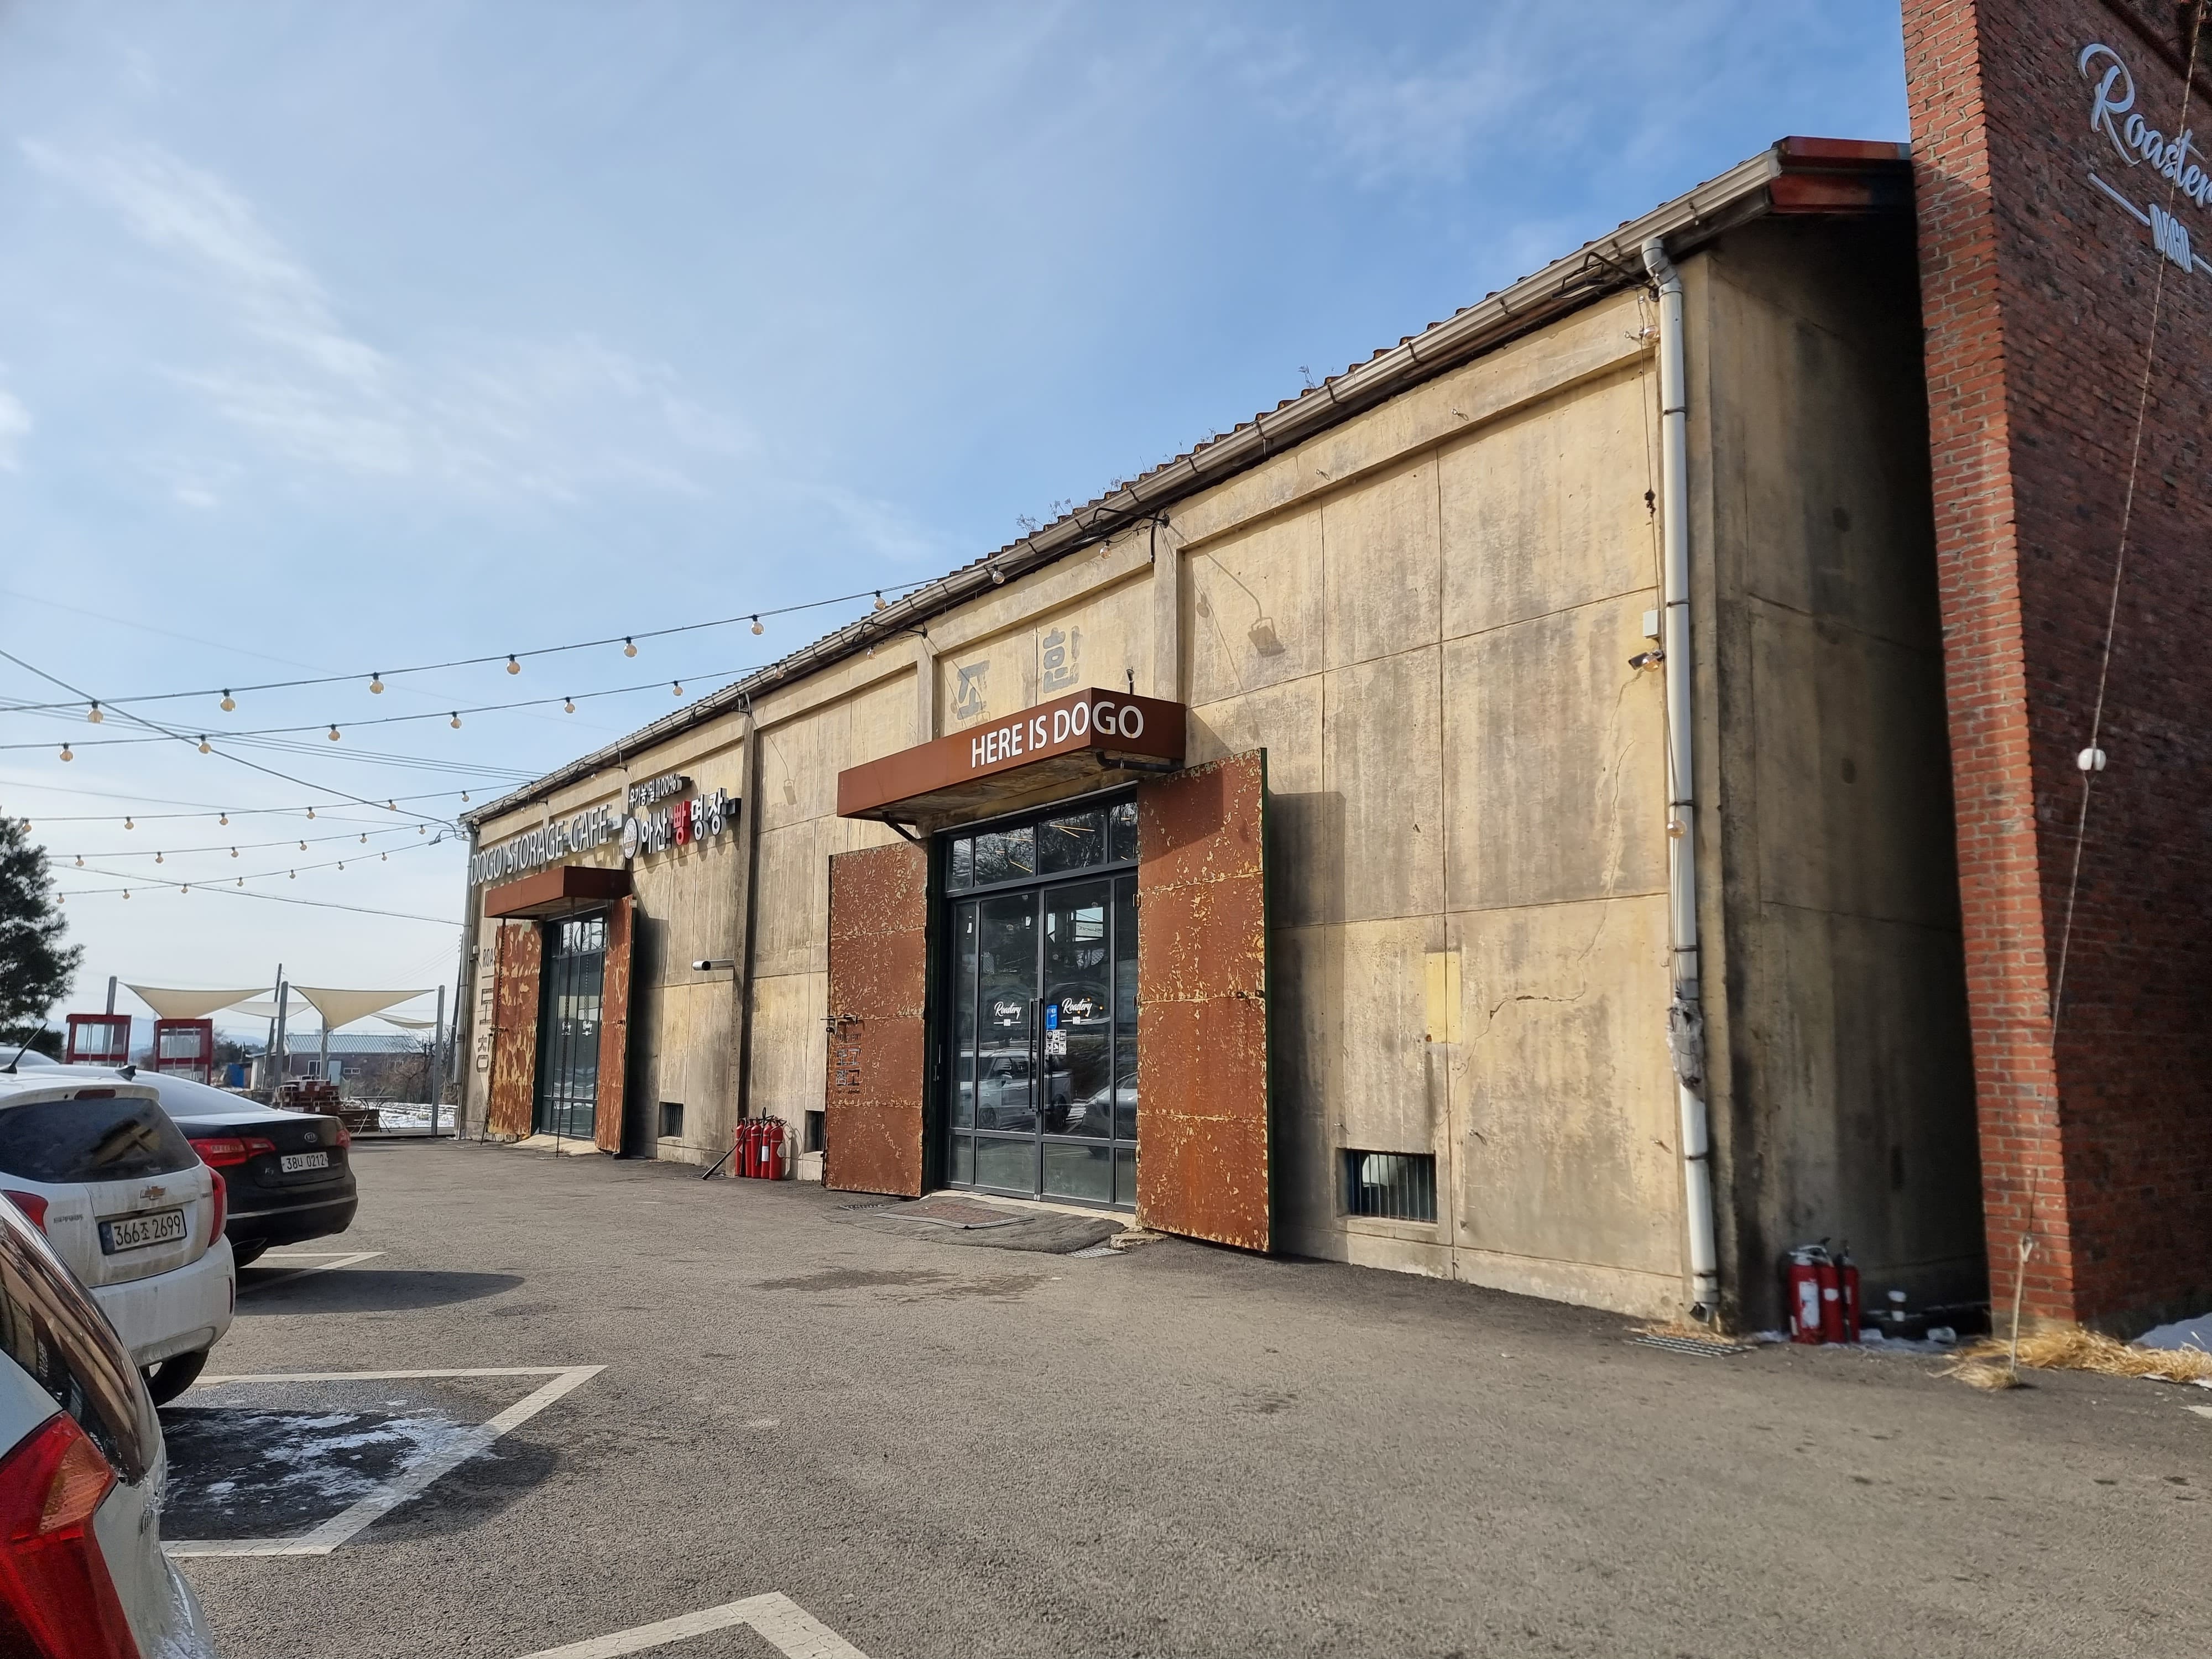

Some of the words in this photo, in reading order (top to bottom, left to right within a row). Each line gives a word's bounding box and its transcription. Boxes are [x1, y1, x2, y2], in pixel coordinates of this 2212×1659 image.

[972, 723, 1022, 768] HERE
[1029, 715, 1047, 752] IS
[1053, 701, 1144, 744] DOGO
[629, 784, 647, 809] 유기농
[649, 779, 655, 802] 밀
[658, 774, 677, 797] 100%
[471, 844, 503, 886] DOGO
[507, 820, 565, 874] STORAGE
[570, 804, 609, 853] CAFE
[482, 948, 494, 968] ROA
[994, 1001, 1022, 1020] Roastery
[1062, 998, 1092, 1018] Roastery
[306, 1154, 325, 1167] 0212
[113, 1222, 149, 1246] 366조
[154, 1214, 181, 1239] 2699
